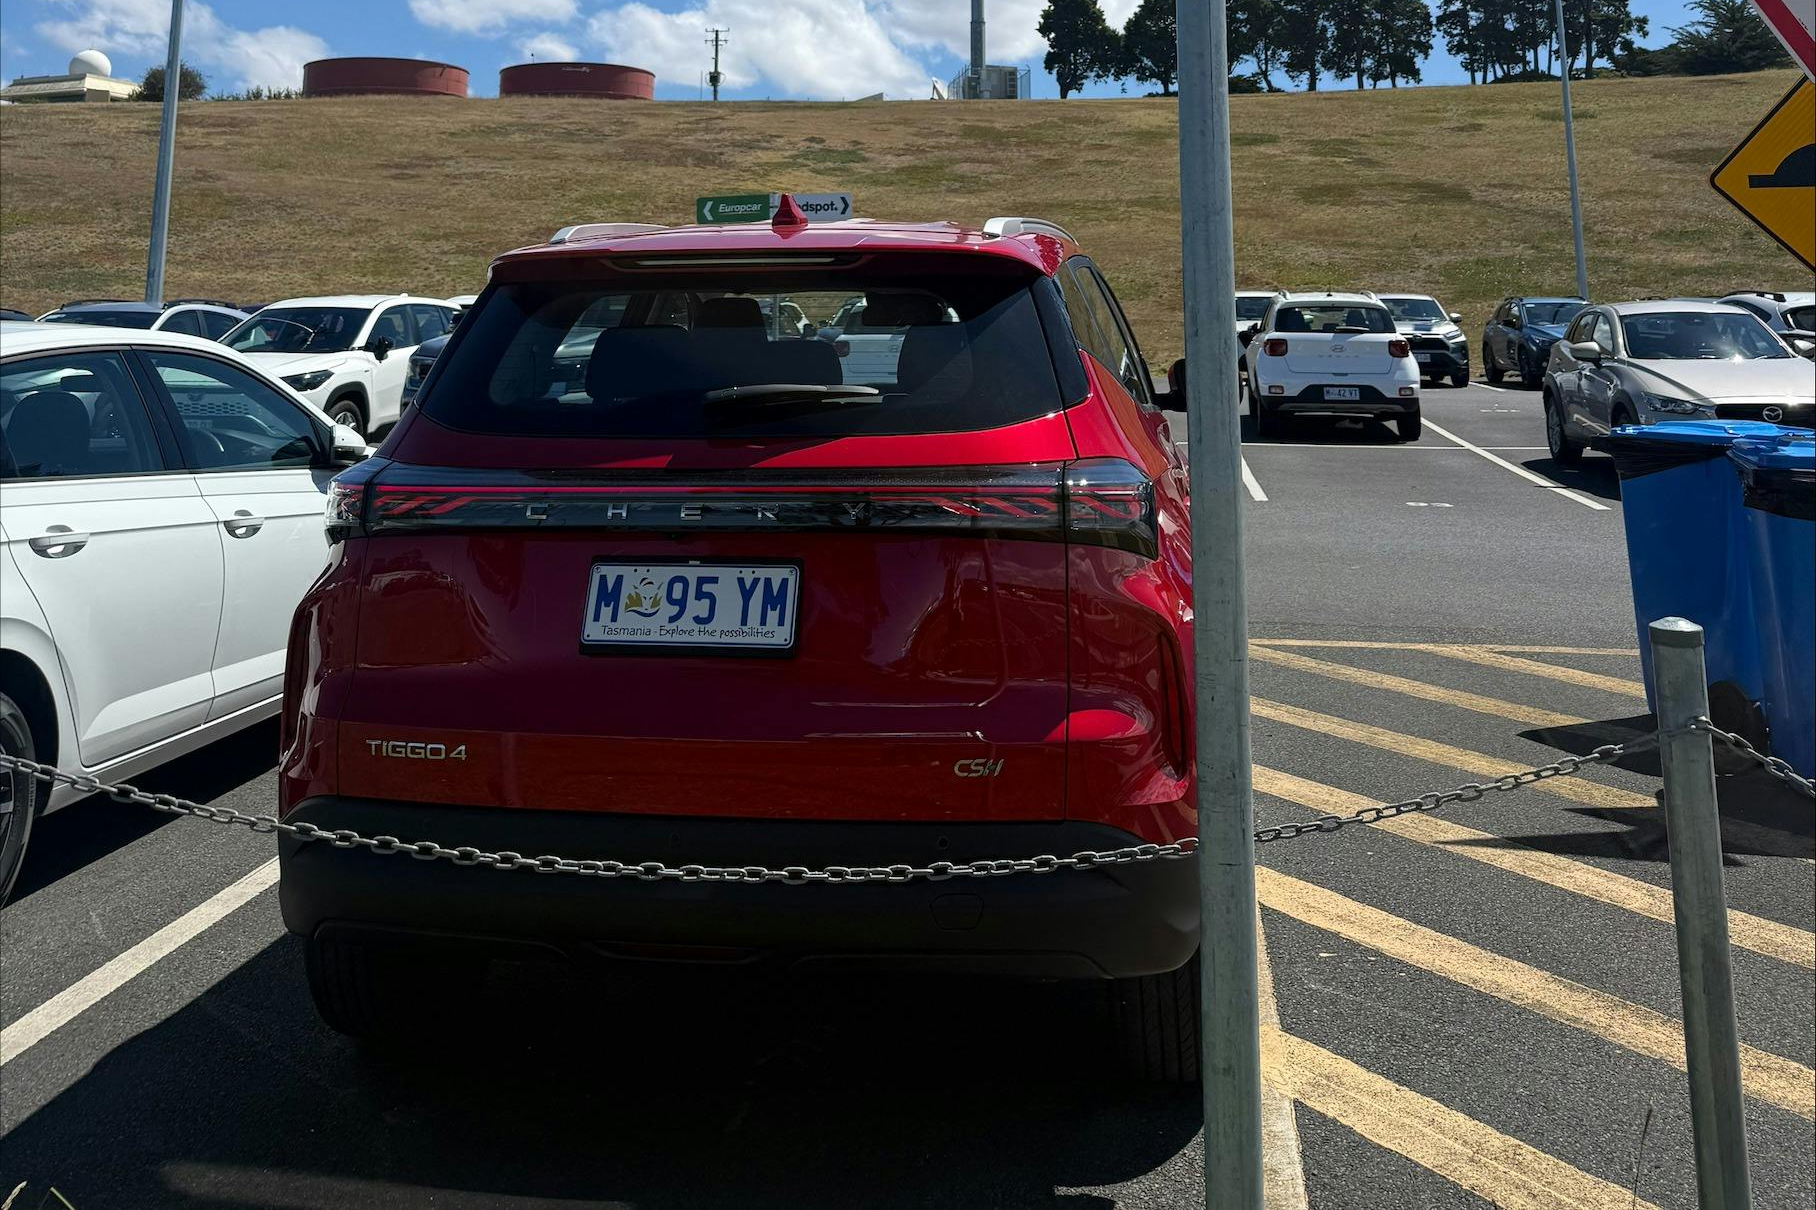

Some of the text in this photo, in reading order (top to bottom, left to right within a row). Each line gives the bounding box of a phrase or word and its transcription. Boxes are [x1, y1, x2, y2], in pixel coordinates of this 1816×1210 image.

[718, 203, 763, 214] Europcar
[525, 502, 866, 521] CHERY
[736, 577, 790, 627] YM
[601, 625, 651, 637] Tasmania
[659, 625, 695, 638] Explore
[698, 626, 717, 637] the
[719, 626, 776, 639] possibilities
